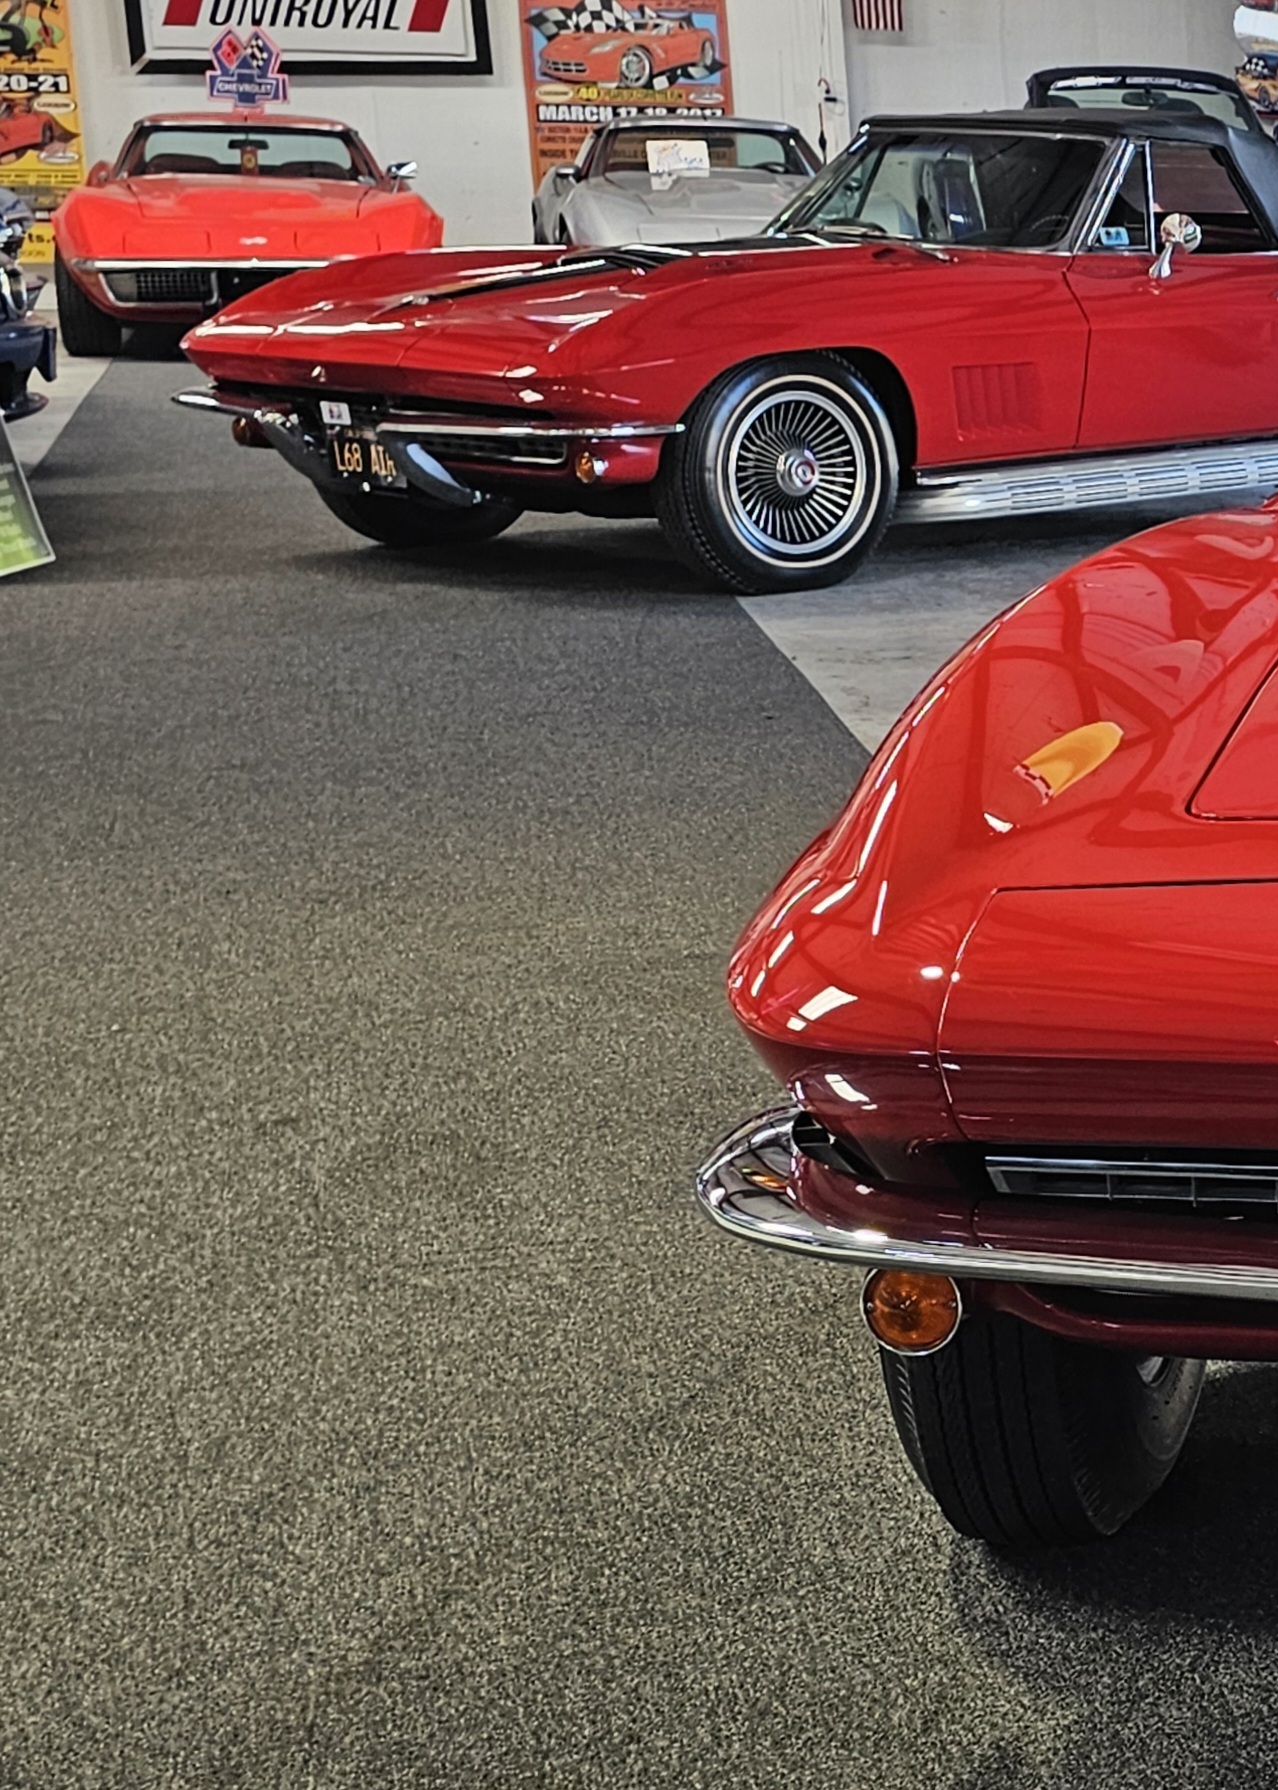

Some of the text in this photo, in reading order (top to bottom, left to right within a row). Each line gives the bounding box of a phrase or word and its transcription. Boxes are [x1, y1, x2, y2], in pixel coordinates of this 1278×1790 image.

[218, 81, 272, 93] CHEVROLET
[538, 104, 613, 122] MARCH
[333, 440, 363, 472] L68
